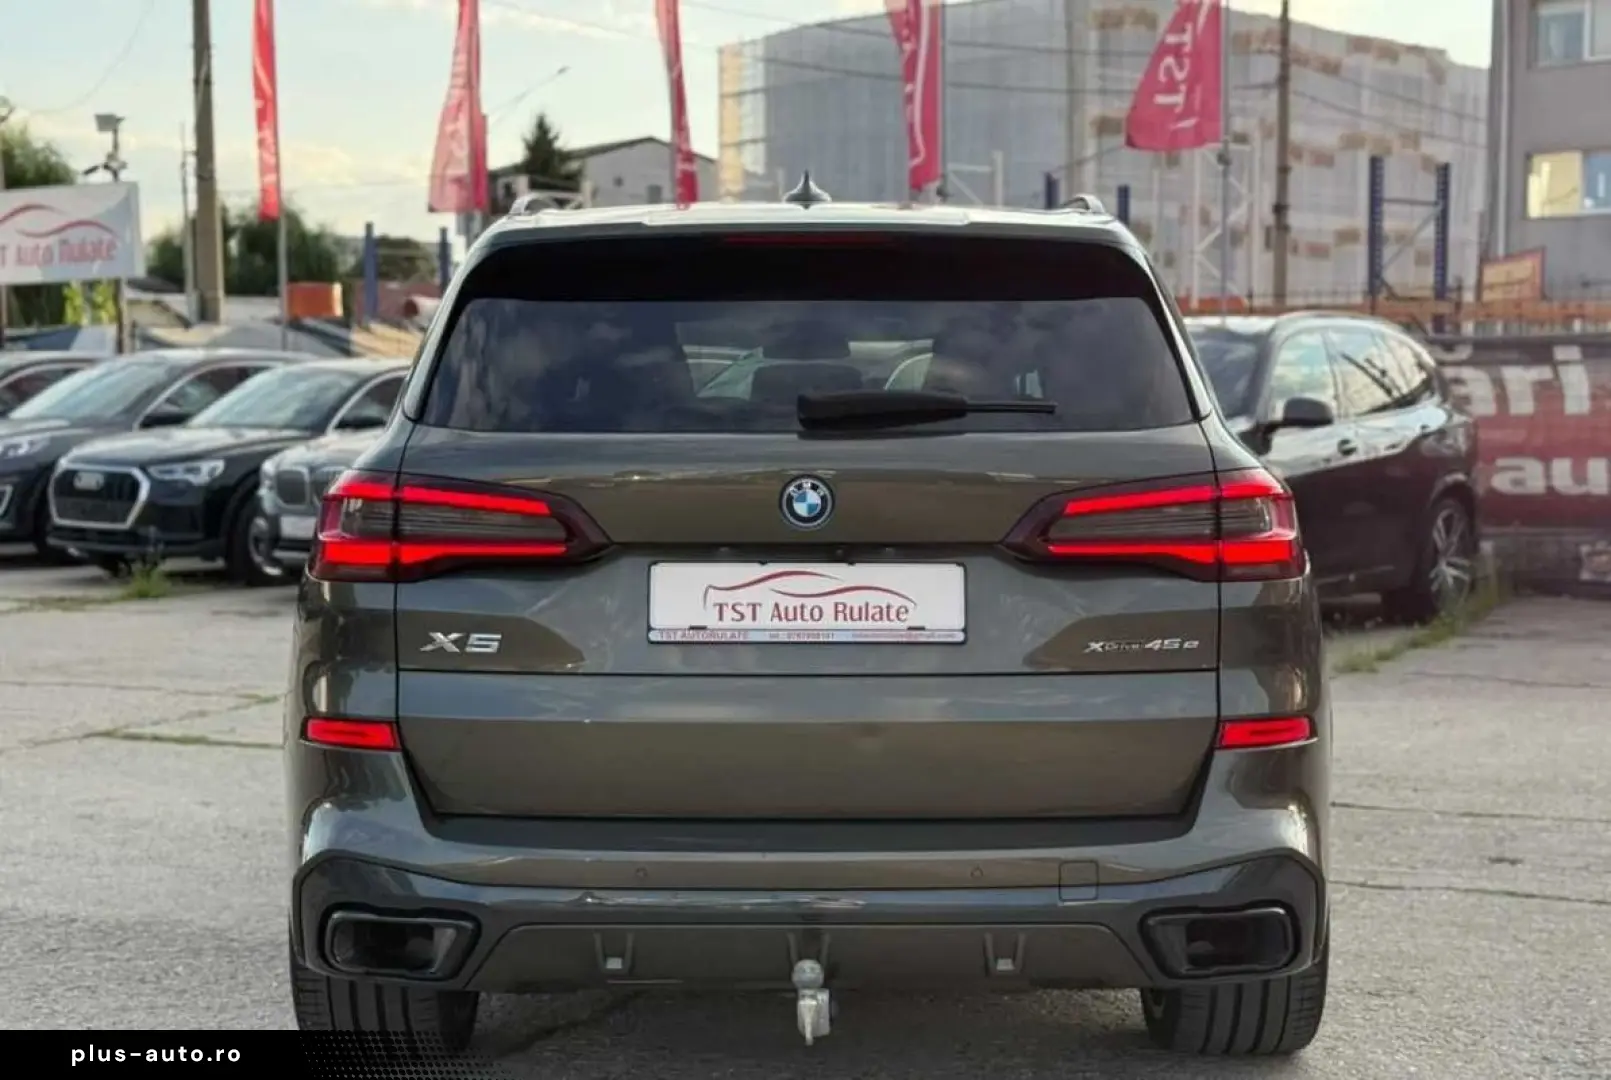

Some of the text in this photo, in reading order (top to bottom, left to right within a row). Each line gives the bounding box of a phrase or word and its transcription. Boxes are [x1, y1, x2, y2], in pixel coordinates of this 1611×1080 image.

[712, 601, 910, 622] TST Auto Rulate
[419, 631, 502, 653] X5
